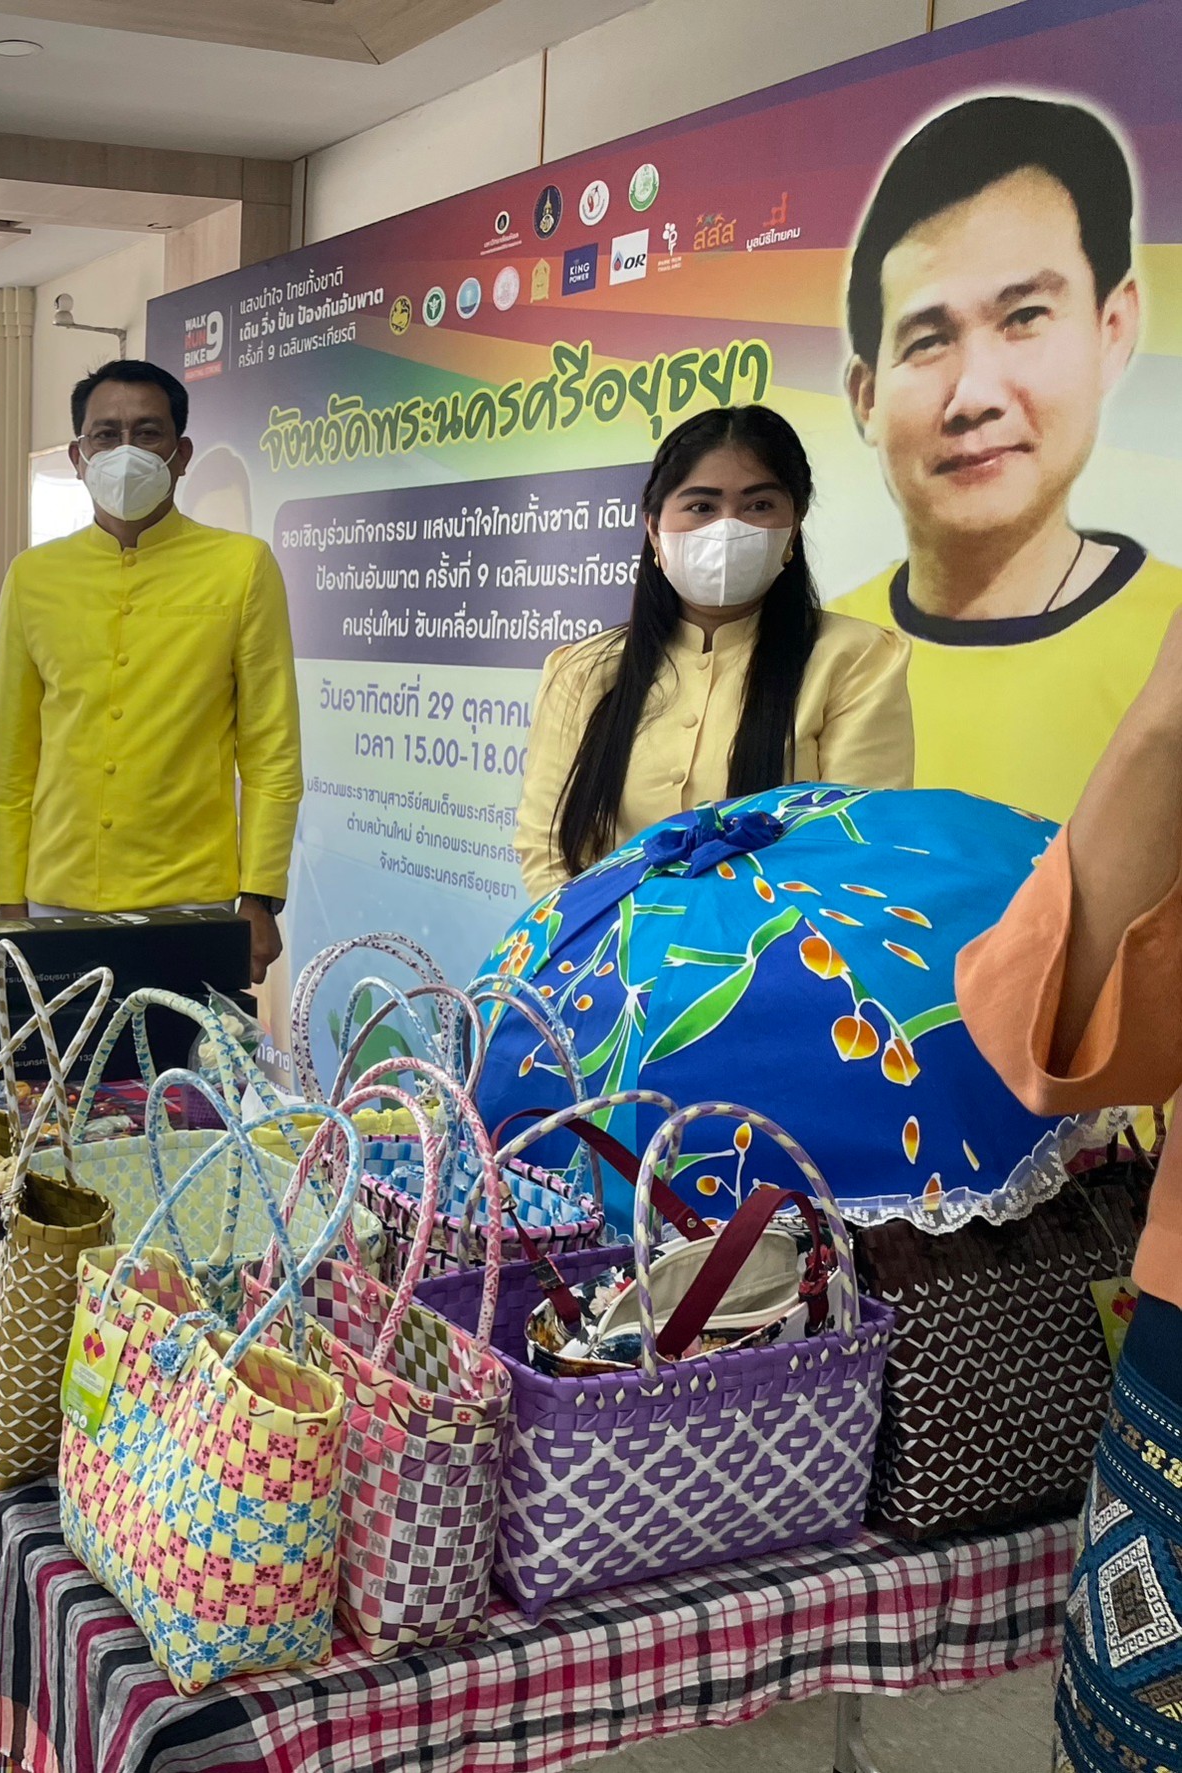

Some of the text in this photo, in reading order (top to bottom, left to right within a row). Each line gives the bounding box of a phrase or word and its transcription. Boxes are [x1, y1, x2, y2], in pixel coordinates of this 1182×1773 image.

[569, 262, 590, 276] KING
[569, 273, 589, 284] POWER
[624, 253, 646, 270] OR
[240, 266, 344, 315] แสงนำใจ ไทยทั้งชาติ
[185, 314, 206, 332] WALK
[239, 287, 384, 341] เดิน วิ่ง ปั่น ป้องกันอัมพาต
[184, 348, 206, 368] BIKE
[206, 311, 224, 362] 9
[238, 322, 356, 368] ครั้งที่ 9 เฉลิมพระเกียรติ
[261, 342, 769, 469] จังหวัดพระนครศรีอยุธยา
[281, 494, 636, 552] ขอเชิญร่วมกิจกรรม แสงนำใจไทยทั้งชาติ เดิน
[316, 563, 419, 591] ป้องกันอัมพาต
[425, 551, 472, 588] ครั้งที่
[477, 563, 489, 587] 9
[343, 608, 410, 645] คนรุ่นใหม่
[320, 674, 421, 718] วันอาทิตย์ที่
[427, 691, 454, 720] 29
[355, 732, 394, 760] เวลา
[306, 777, 520, 832] บริเวณพระราชานุสาวรีย์สมเด็จพระศรีสุริโ
[346, 812, 412, 842] ตำบลบ้านใหม่
[379, 851, 517, 900] จังหวัดพระนครศรีอยุธยา
